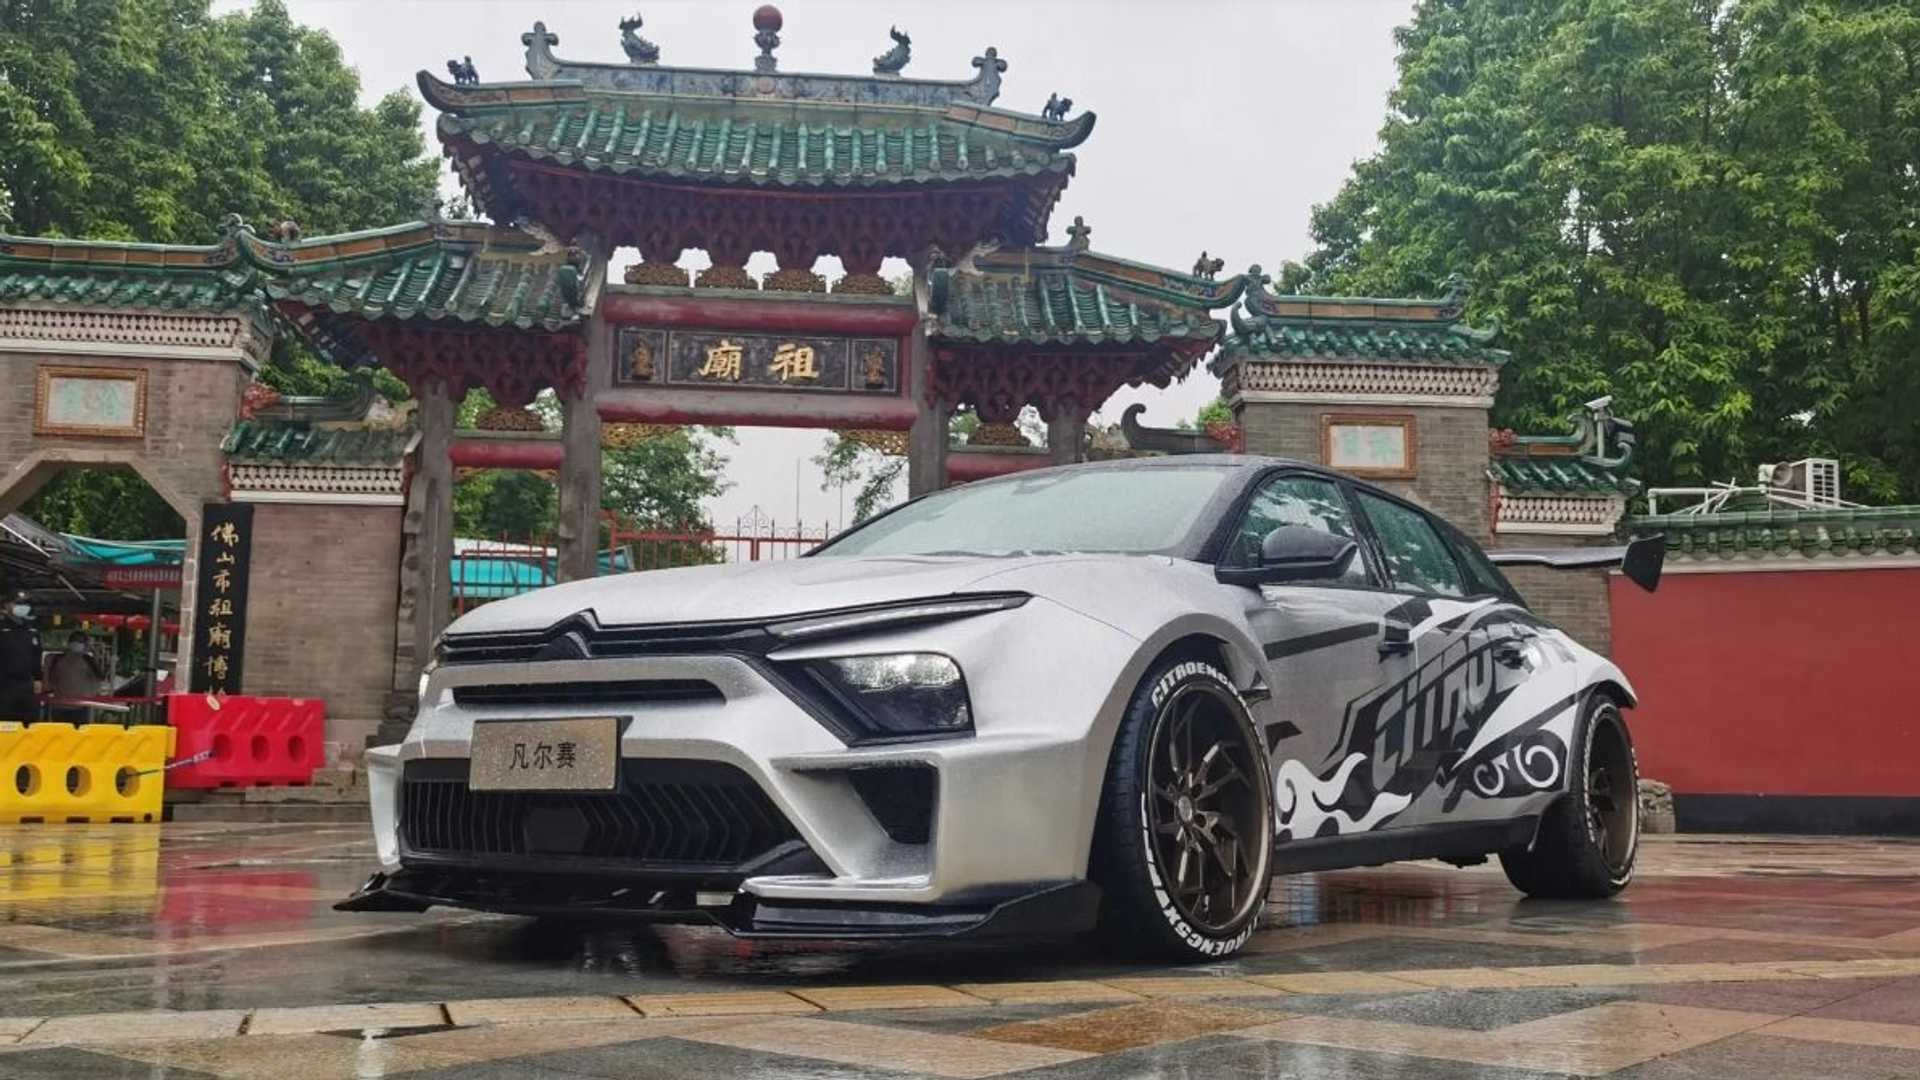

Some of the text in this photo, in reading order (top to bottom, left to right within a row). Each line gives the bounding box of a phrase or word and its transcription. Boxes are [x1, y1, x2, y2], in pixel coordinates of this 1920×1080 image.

[203, 520, 240, 694] 佛山市祖廟博
[510, 741, 577, 769] 凡尔赛
